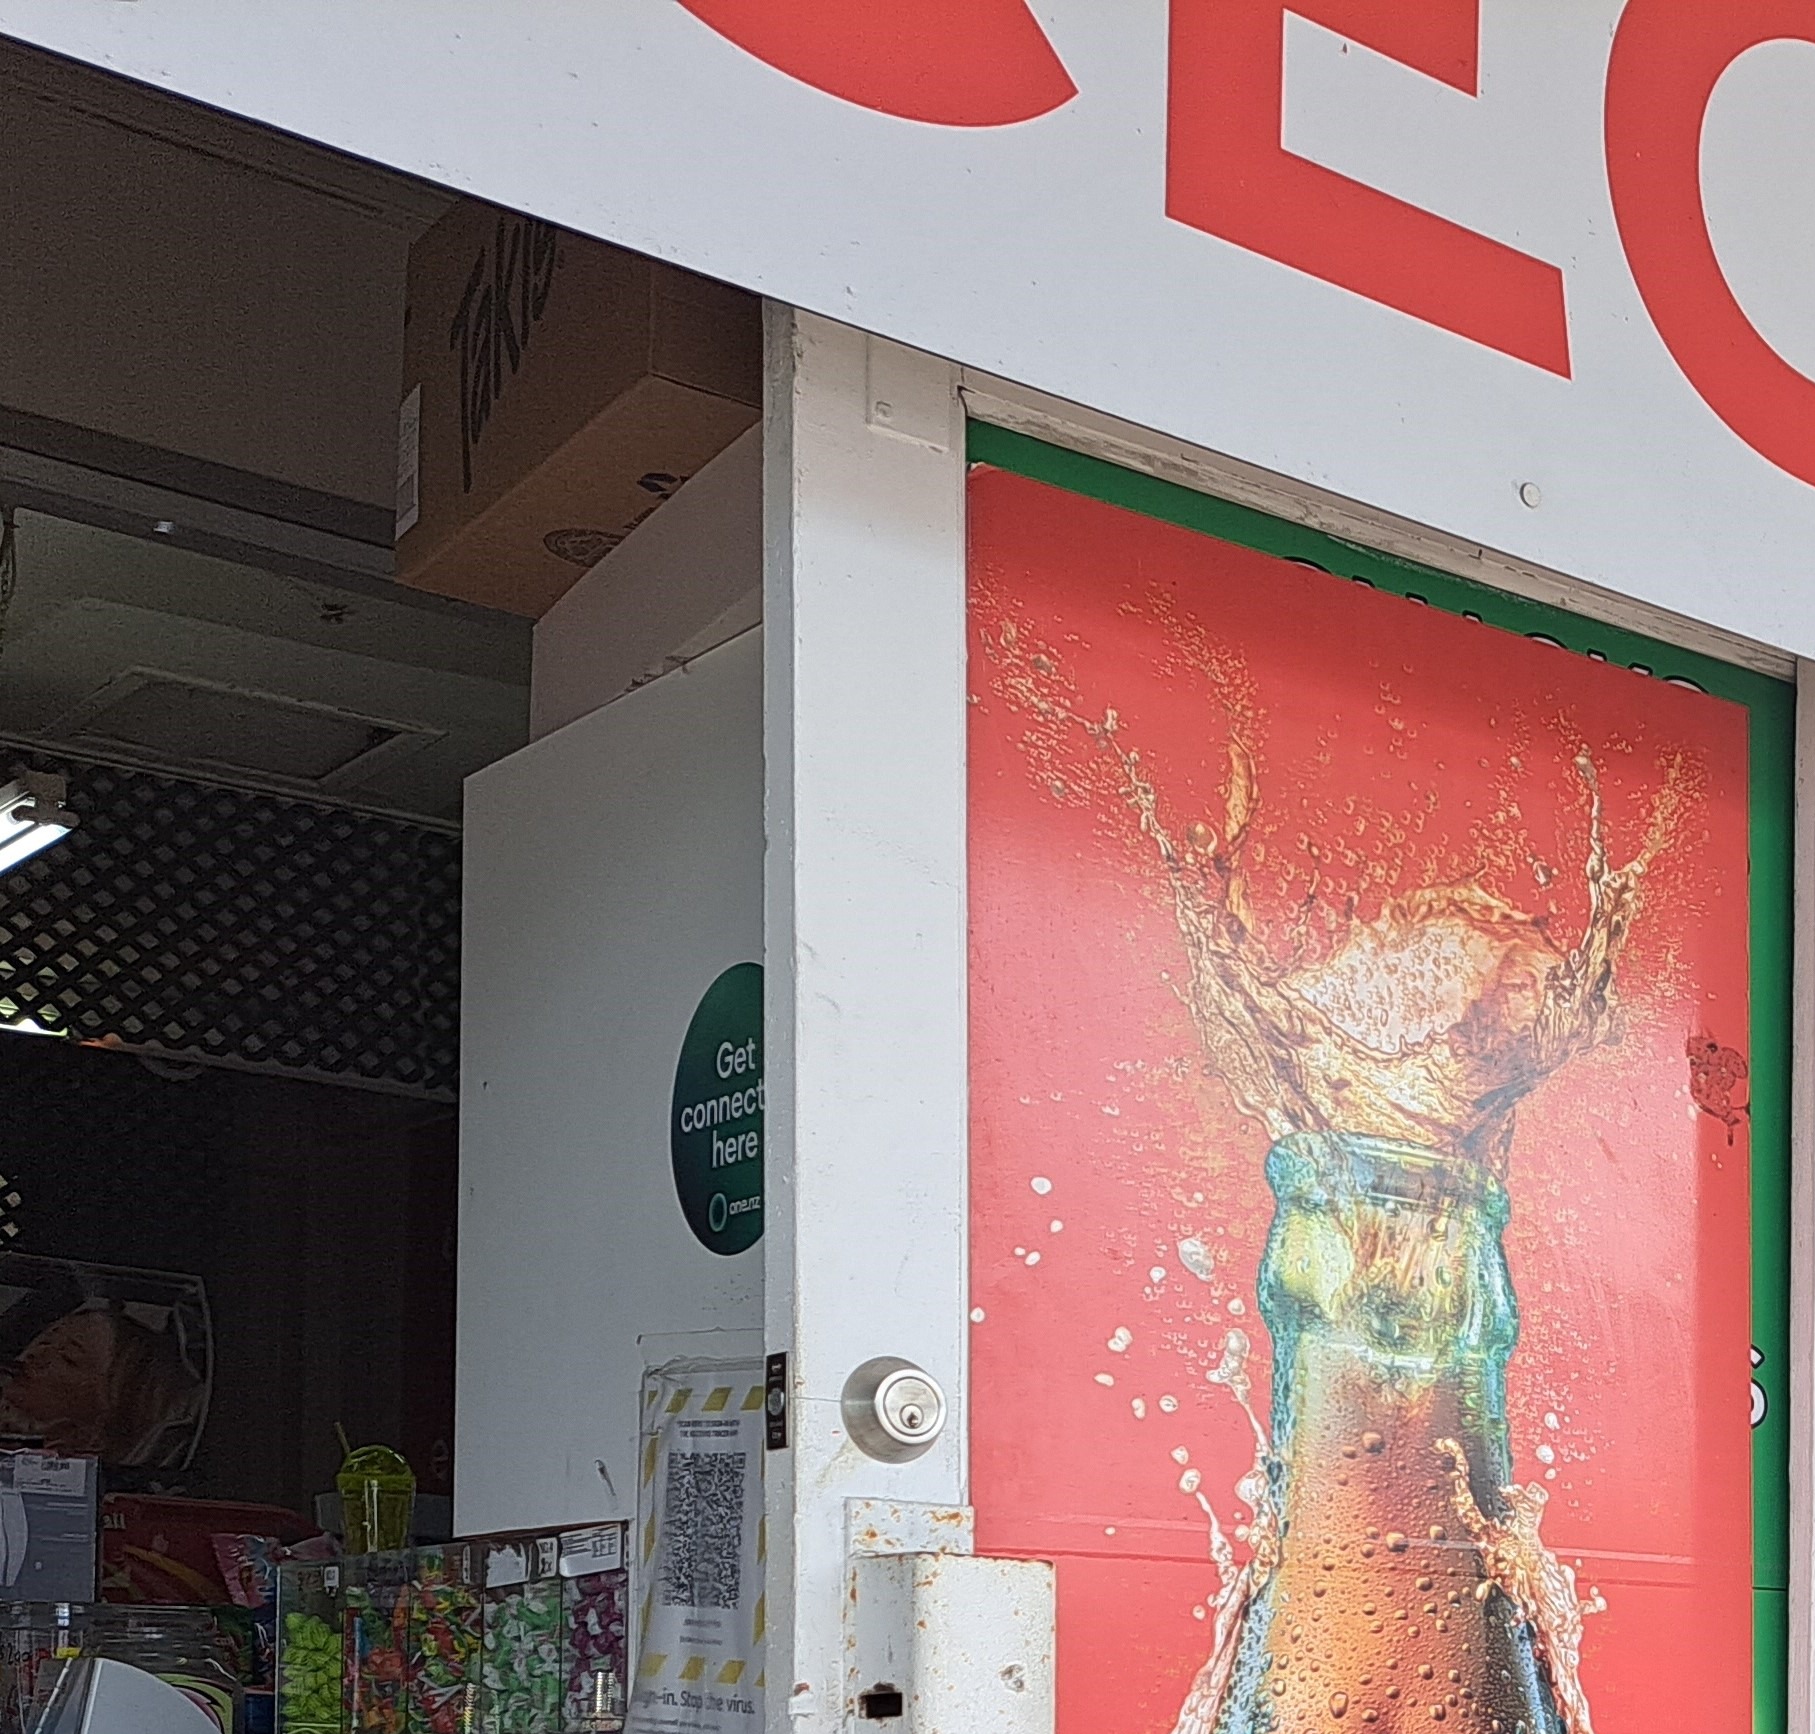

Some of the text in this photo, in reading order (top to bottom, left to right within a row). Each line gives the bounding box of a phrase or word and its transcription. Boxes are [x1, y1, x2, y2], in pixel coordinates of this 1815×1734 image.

[716, 1037, 756, 1079] Get
[680, 1078, 765, 1133] connect
[712, 1130, 758, 1169] here
[680, 1690, 703, 1714] Stop
[726, 1693, 756, 1715] virus.
